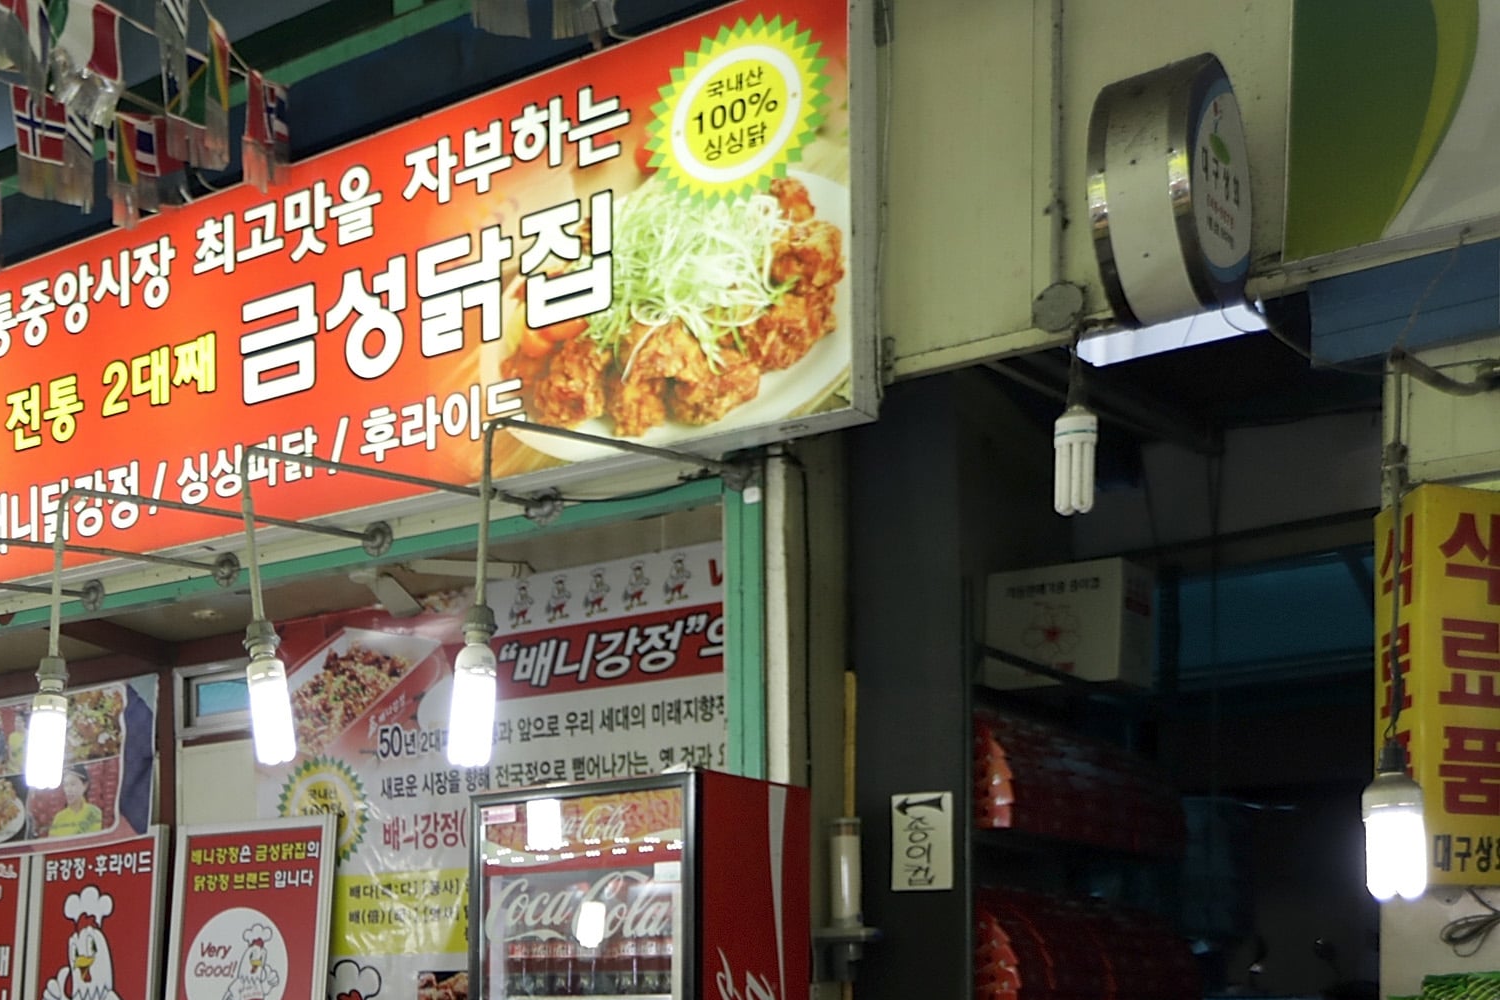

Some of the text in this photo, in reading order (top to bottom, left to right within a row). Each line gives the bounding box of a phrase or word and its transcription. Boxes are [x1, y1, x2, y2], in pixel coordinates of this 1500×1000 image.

[707, 66, 763, 98] 국내산
[693, 88, 778, 134] 100%
[704, 122, 767, 161] 싱싱닭
[192, 165, 383, 277] 최고맛을
[401, 86, 631, 204] 자부하는
[239, 188, 615, 406] 금성닭집
[5, 374, 84, 451] 전통
[101, 332, 217, 418] 2대째
[176, 426, 318, 506] 싱싱파닭
[360, 377, 526, 463] 후라이드
[378, 726, 416, 758] 50년
[517, 716, 560, 742] 앞으로
[565, 709, 593, 736] 우리
[600, 703, 645, 733] 세대의
[380, 774, 418, 800] 새로운
[422, 769, 460, 797] 시장을
[191, 841, 320, 866] 배니강정은 금성닭집의
[193, 869, 314, 893] 닭강정 브랜드 입니다
[194, 960, 238, 979] Good!
[200, 941, 232, 960] Very
